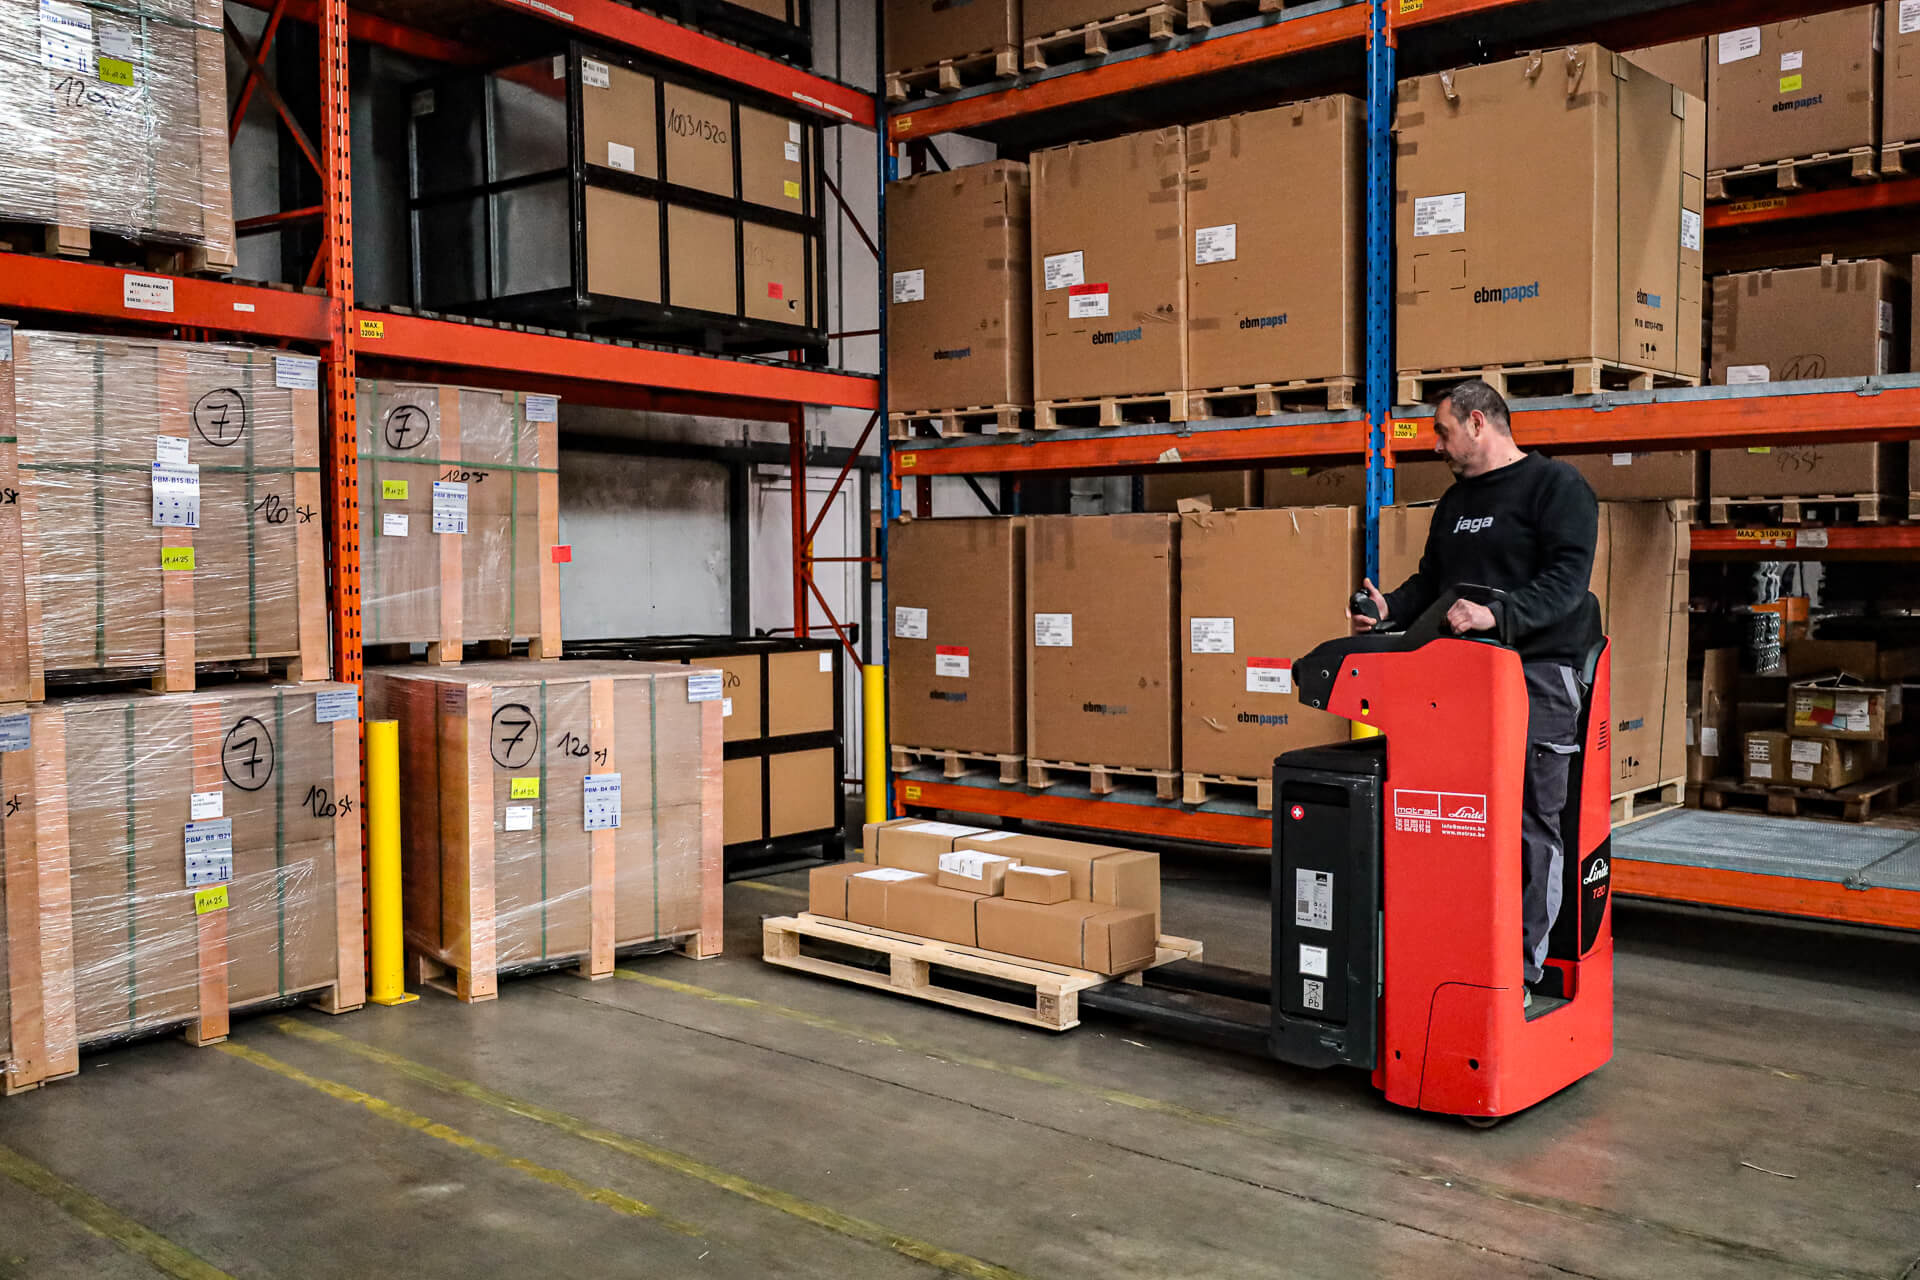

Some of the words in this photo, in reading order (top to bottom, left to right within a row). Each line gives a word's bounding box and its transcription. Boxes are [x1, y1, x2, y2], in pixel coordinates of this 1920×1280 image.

[1773, 94, 1823, 113] ebmpapst
[668, 108, 728, 144] 10031520
[1474, 281, 1539, 304] ebmpapst
[1239, 312, 1287, 330] ebmpapst
[1092, 327, 1142, 345] ebmpapst
[1453, 515, 1494, 534] jaga
[1237, 711, 1289, 726] ebmpapst
[1397, 807, 1438, 816] motrac
[1447, 806, 1485, 819] Linde
[1308, 999, 1320, 1008] Pb
